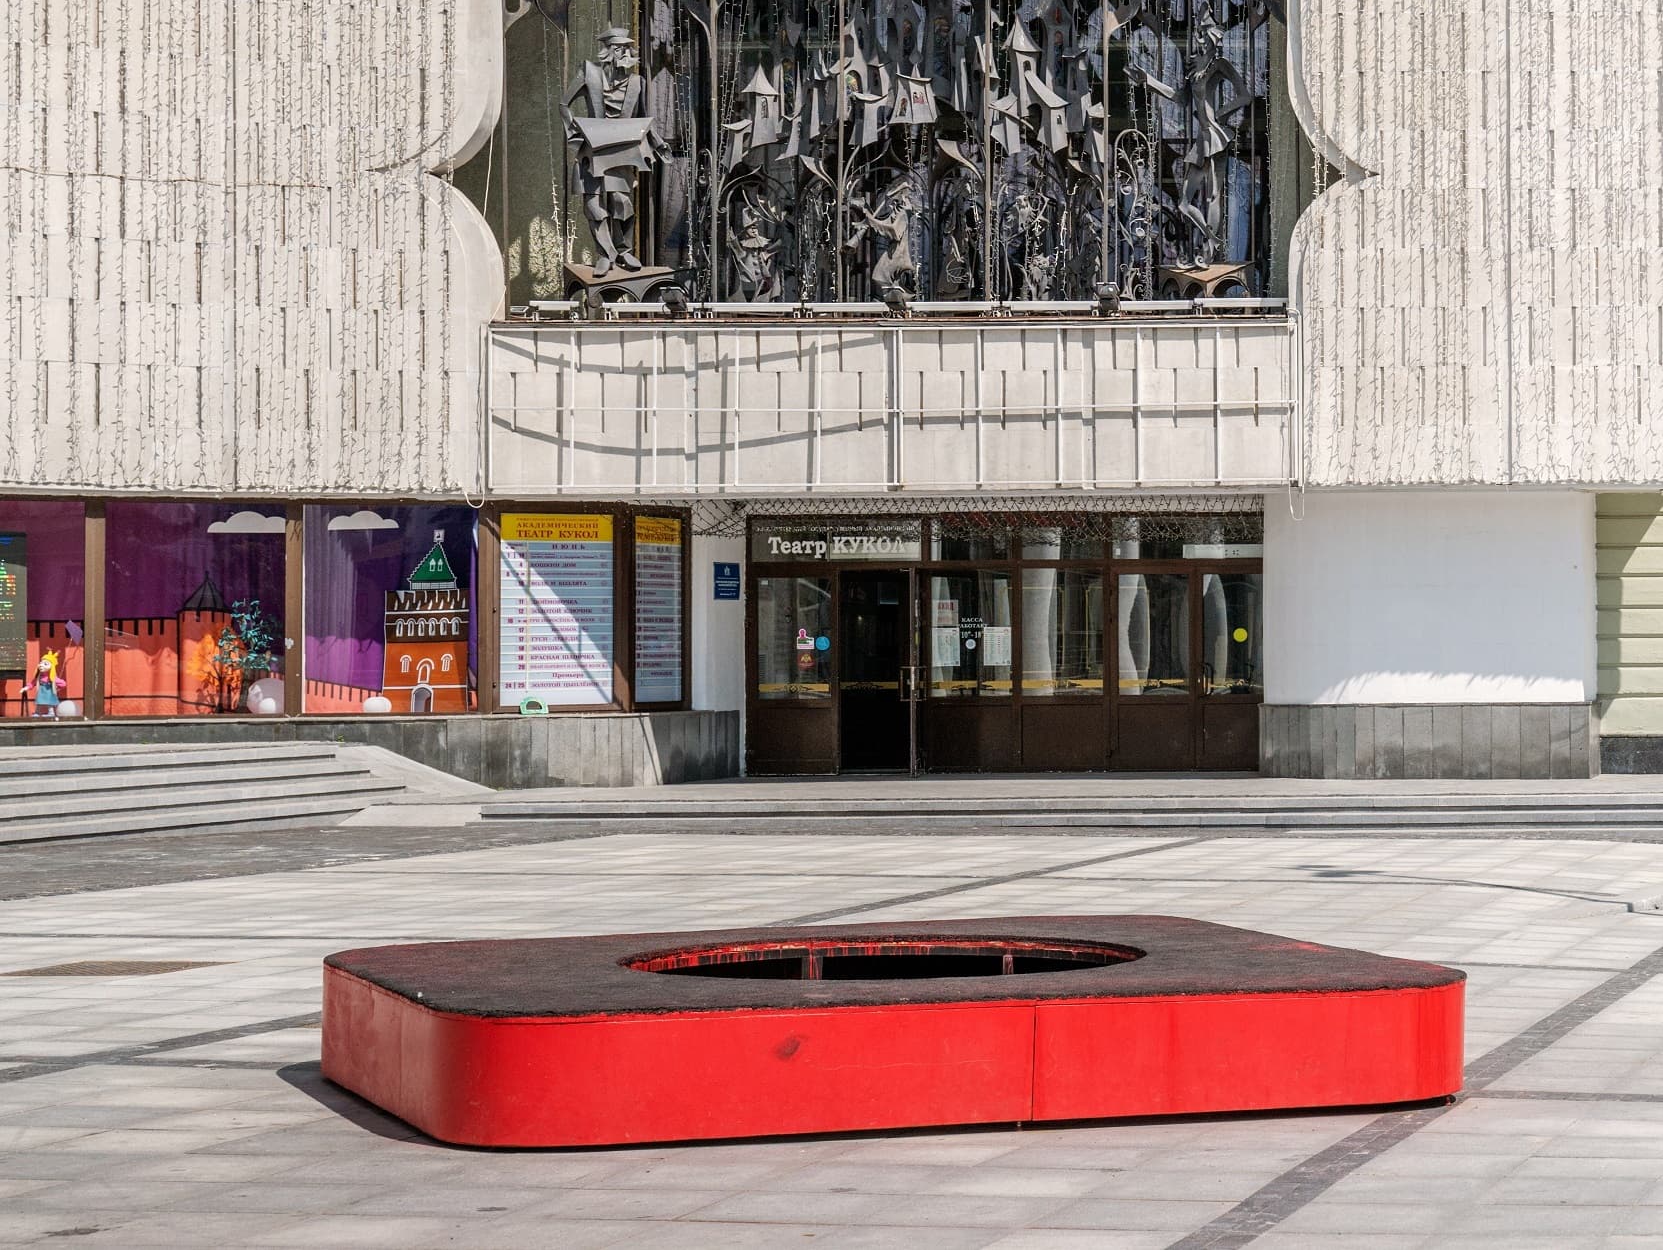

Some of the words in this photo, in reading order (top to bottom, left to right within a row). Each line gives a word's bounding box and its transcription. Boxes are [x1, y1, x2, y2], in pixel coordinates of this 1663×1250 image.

[517, 530, 553, 538] ТЕАТР
[559, 530, 600, 539] КУКОЛ
[767, 536, 827, 559] Театр
[832, 536, 905, 554] КУКОЛ
